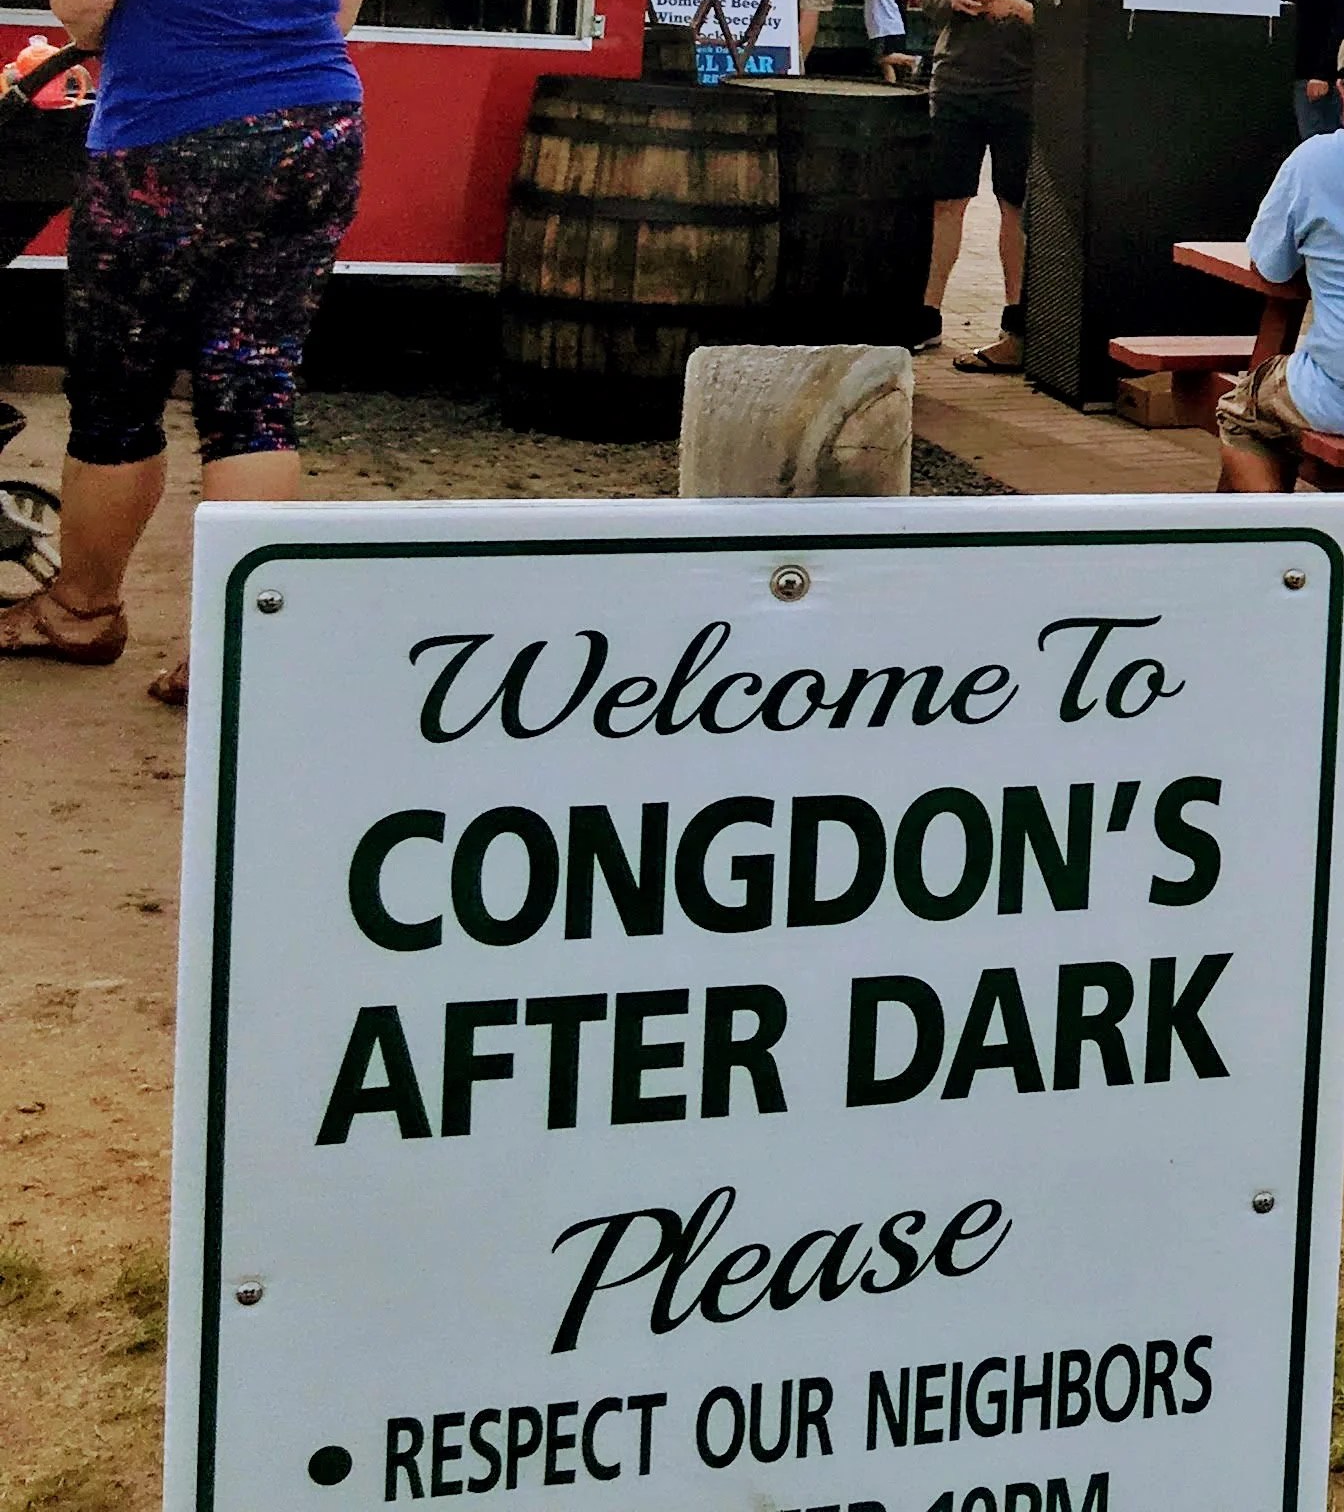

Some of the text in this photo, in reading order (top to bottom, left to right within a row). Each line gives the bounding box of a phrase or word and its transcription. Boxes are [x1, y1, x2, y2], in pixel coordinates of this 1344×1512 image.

[409, 615, 1186, 744] Welcome To
[348, 775, 1223, 952] CONGDON'S
[314, 952, 1235, 1146] AFTER DARK
[550, 1185, 1013, 1355] Please
[384, 1334, 1213, 1503] RESPECT OUR NEIGHBORS
